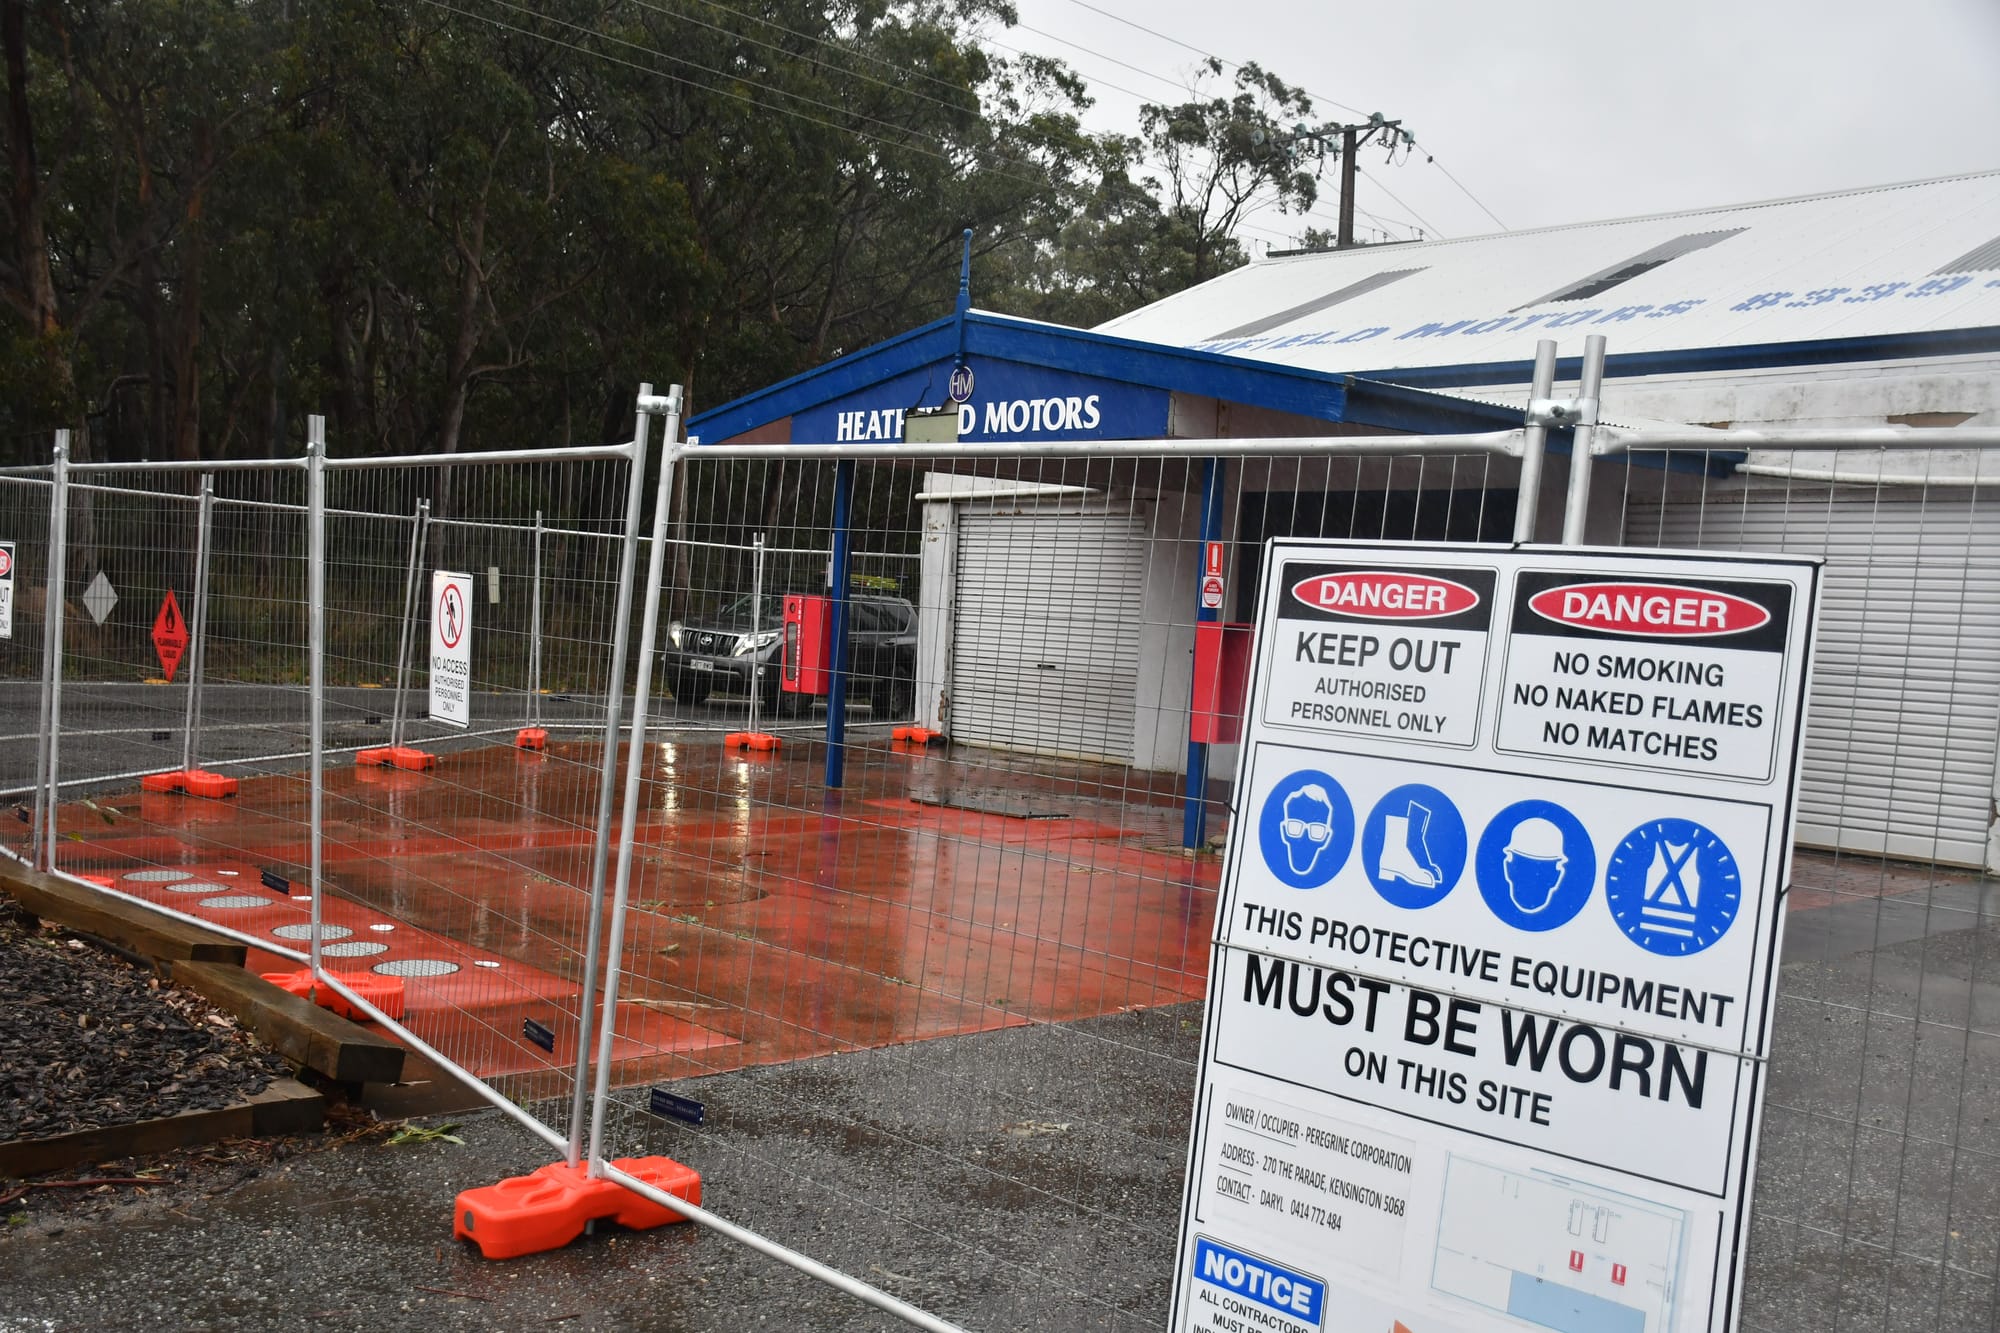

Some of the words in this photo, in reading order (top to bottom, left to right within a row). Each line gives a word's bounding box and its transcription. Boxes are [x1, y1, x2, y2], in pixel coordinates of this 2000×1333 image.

[1393, 298, 1707, 340] MOTORS
[983, 395, 1101, 434] MOTORS
[1319, 580, 1448, 611] DANGER
[1562, 592, 1728, 629] DANGER
[432, 656, 441, 670] NO
[443, 658, 468, 676] ACCESS
[1295, 631, 1379, 668] KEEP
[1389, 637, 1461, 675] OUT
[1553, 651, 1589, 675] NO
[1596, 654, 1724, 688] SMOKING
[434, 674, 465, 690] AUTHORISED
[434, 686, 464, 703] PERSONNEL
[1314, 677, 1427, 704] AUTHORISED
[442, 701, 455, 713] ONLY
[1291, 701, 1392, 728] PERSONNEL
[1397, 712, 1447, 734] ONLY
[1513, 683, 1548, 707] NO
[1555, 687, 1644, 716] NAKED
[1652, 695, 1763, 729] FLAMES
[1543, 721, 1579, 746] NO
[1587, 725, 1719, 762] MATCHES
[1243, 902, 1303, 941] THIS
[1309, 916, 1501, 983] PROTECTIVE
[1510, 955, 1735, 1028] EQUIPMENT
[1243, 952, 1391, 1033] MUST
[1404, 989, 1482, 1057] BE
[1500, 1008, 1708, 1110] WORN
[1344, 1046, 1388, 1084] ON
[1397, 1058, 1468, 1104] THIS
[1476, 1079, 1553, 1127] SITE
[1225, 1102, 1255, 1126] OWNER
[1254, 1109, 1262, 1130] /
[1261, 1113, 1300, 1140] OCCUPIER
[1305, 1126, 1349, 1155] PEREGRINE
[1350, 1140, 1412, 1175] CORPORATION
[1220, 1142, 1255, 1168] ADDRESS
[1262, 1155, 1277, 1175] 270
[1278, 1159, 1293, 1180] THE
[1294, 1165, 1327, 1194] PARADE,
[1328, 1176, 1382, 1210] KENSINGTON
[1383, 1194, 1406, 1217] 5068
[1216, 1175, 1252, 1201] CONTACT
[1260, 1190, 1285, 1213] DARYL
[1290, 1200, 1310, 1221] 0414
[1310, 1206, 1326, 1227] 772
[1326, 1213, 1342, 1232] 484
[1200, 1288, 1220, 1307] ALL
[1203, 1248, 1313, 1315] NOTICE
[1213, 1312, 1245, 1333] MUST
